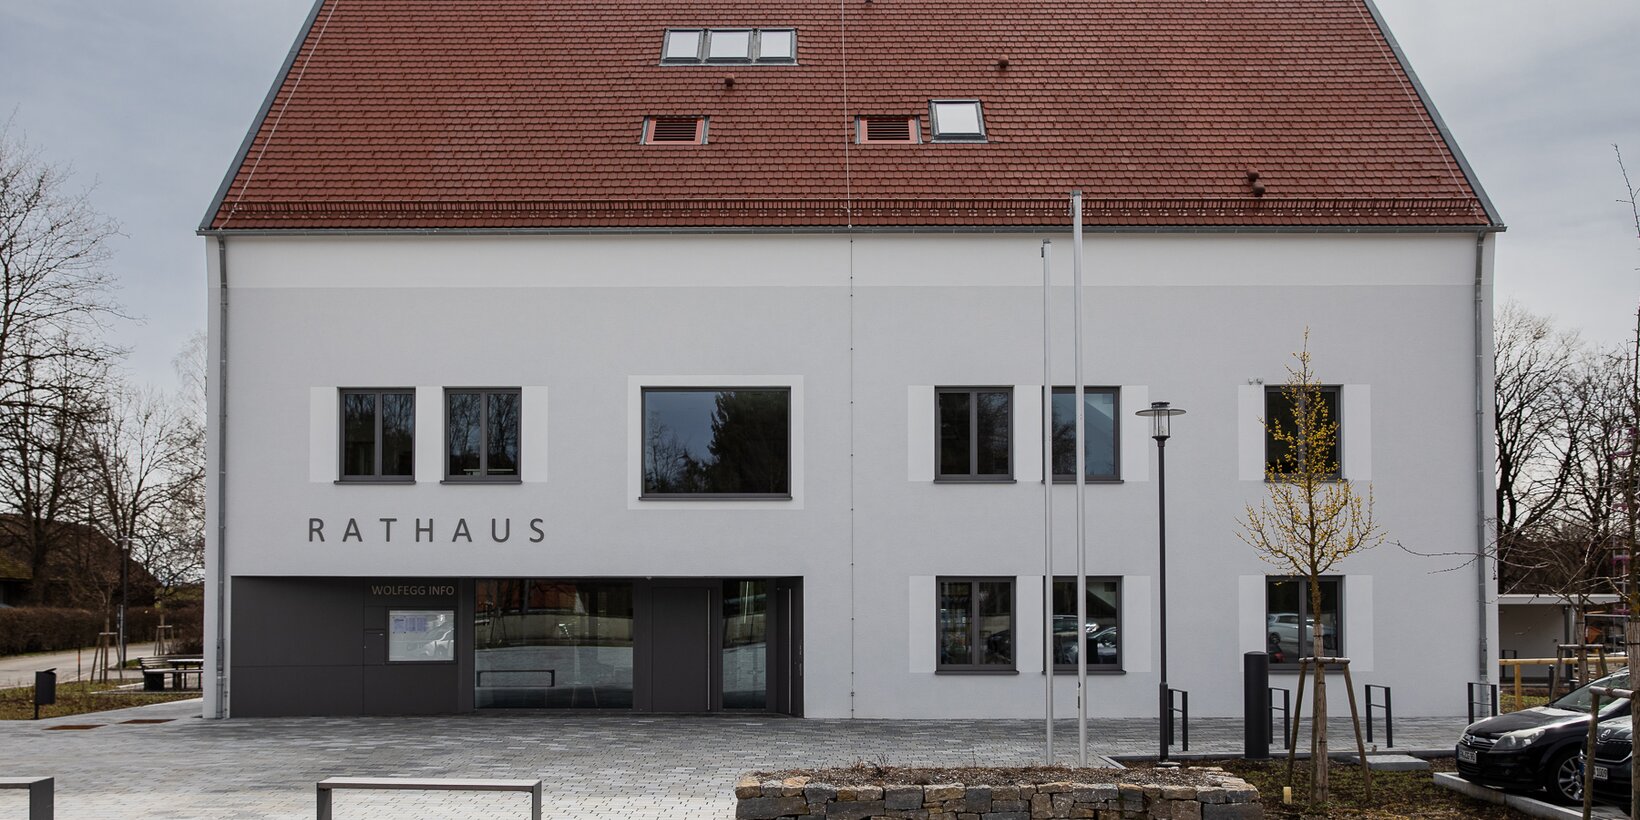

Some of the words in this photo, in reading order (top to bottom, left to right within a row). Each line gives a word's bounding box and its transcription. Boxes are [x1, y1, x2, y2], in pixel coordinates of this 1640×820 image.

[308, 518, 545, 542] RATHAUS
[371, 585, 426, 596] WOLFEGG
[428, 585, 455, 596] INFO
